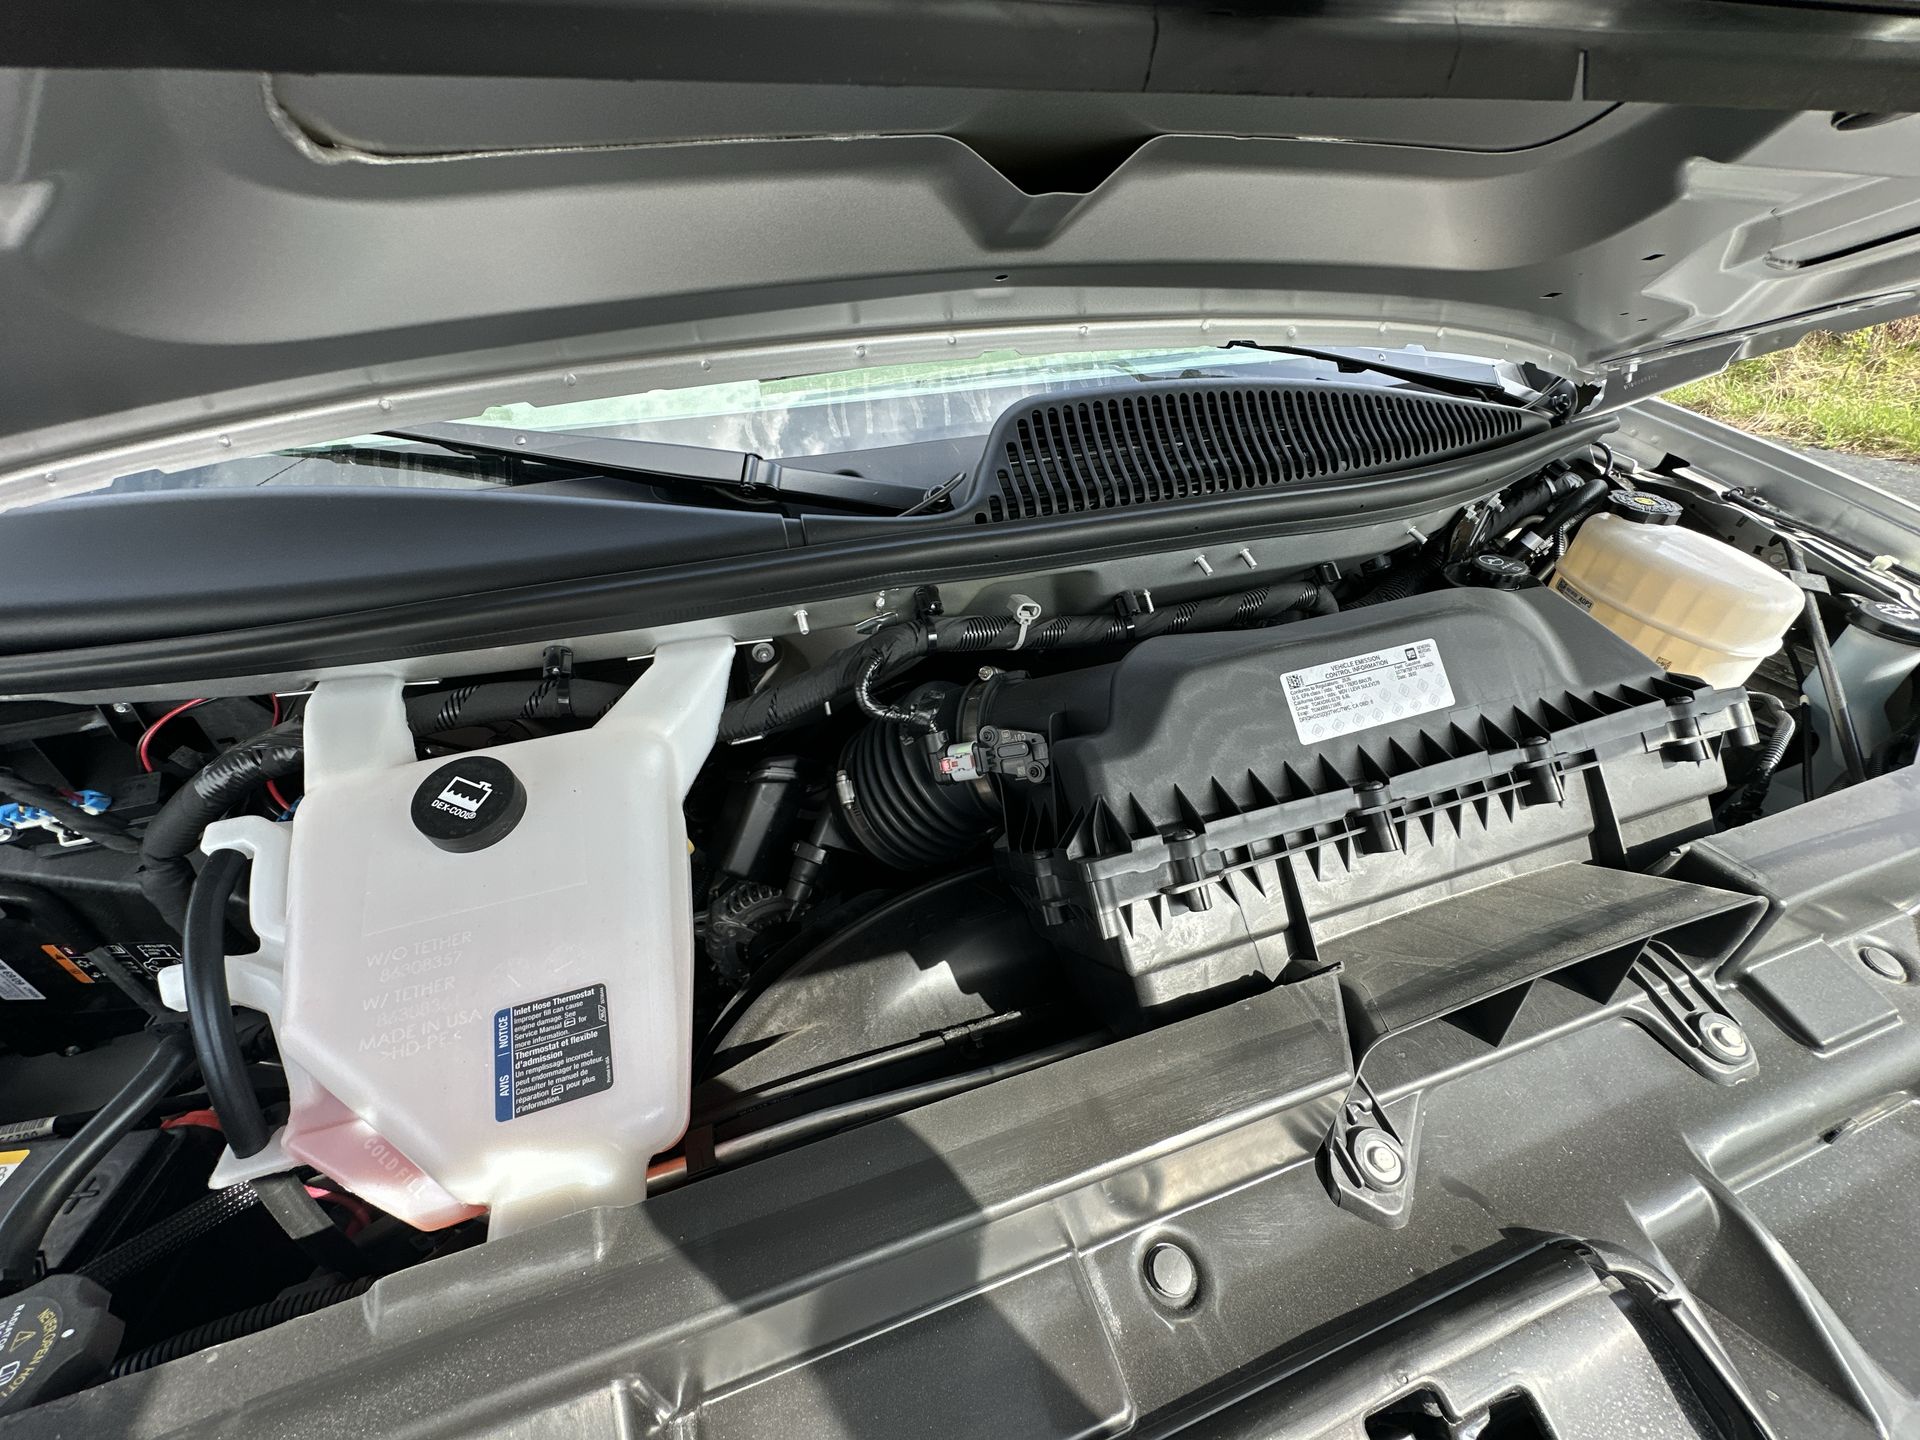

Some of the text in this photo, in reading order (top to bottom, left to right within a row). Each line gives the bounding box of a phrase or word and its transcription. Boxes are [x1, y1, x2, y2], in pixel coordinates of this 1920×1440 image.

[1325, 669, 1352, 679] CONTROL
[1352, 659, 1389, 672] INFORMATION
[1331, 655, 1381, 671] VEHICLE EMISSION
[366, 931, 472, 968] W/O TETHER
[363, 976, 456, 1012] W/ TETHER
[513, 1007, 531, 1017] Inlet
[532, 1000, 551, 1013] Hose
[552, 987, 595, 1006] Thermostat
[513, 1000, 584, 1026] Improper fill can cause
[513, 1010, 577, 1034] engine damage. See
[513, 1014, 588, 1041] Service Manual for
[358, 1009, 483, 1052] MADE IN USA
[498, 1015, 509, 1049] NOTICE
[514, 1028, 569, 1050] more information.
[514, 1029, 599, 1060] Thermostat et flexible
[515, 1049, 563, 1070] d'admission
[515, 1049, 594, 1079] Un remplissage incorrect
[515, 1055, 604, 1088] peut endommager le moteur.
[499, 1074, 510, 1097] AVIS
[515, 1068, 589, 1096] Consulter le manuel de
[566, 1080, 581, 1091] pour
[581, 1075, 597, 1086] plus
[363, 1138, 399, 1170] COLD
[29, 1333, 56, 1365] OPEN
